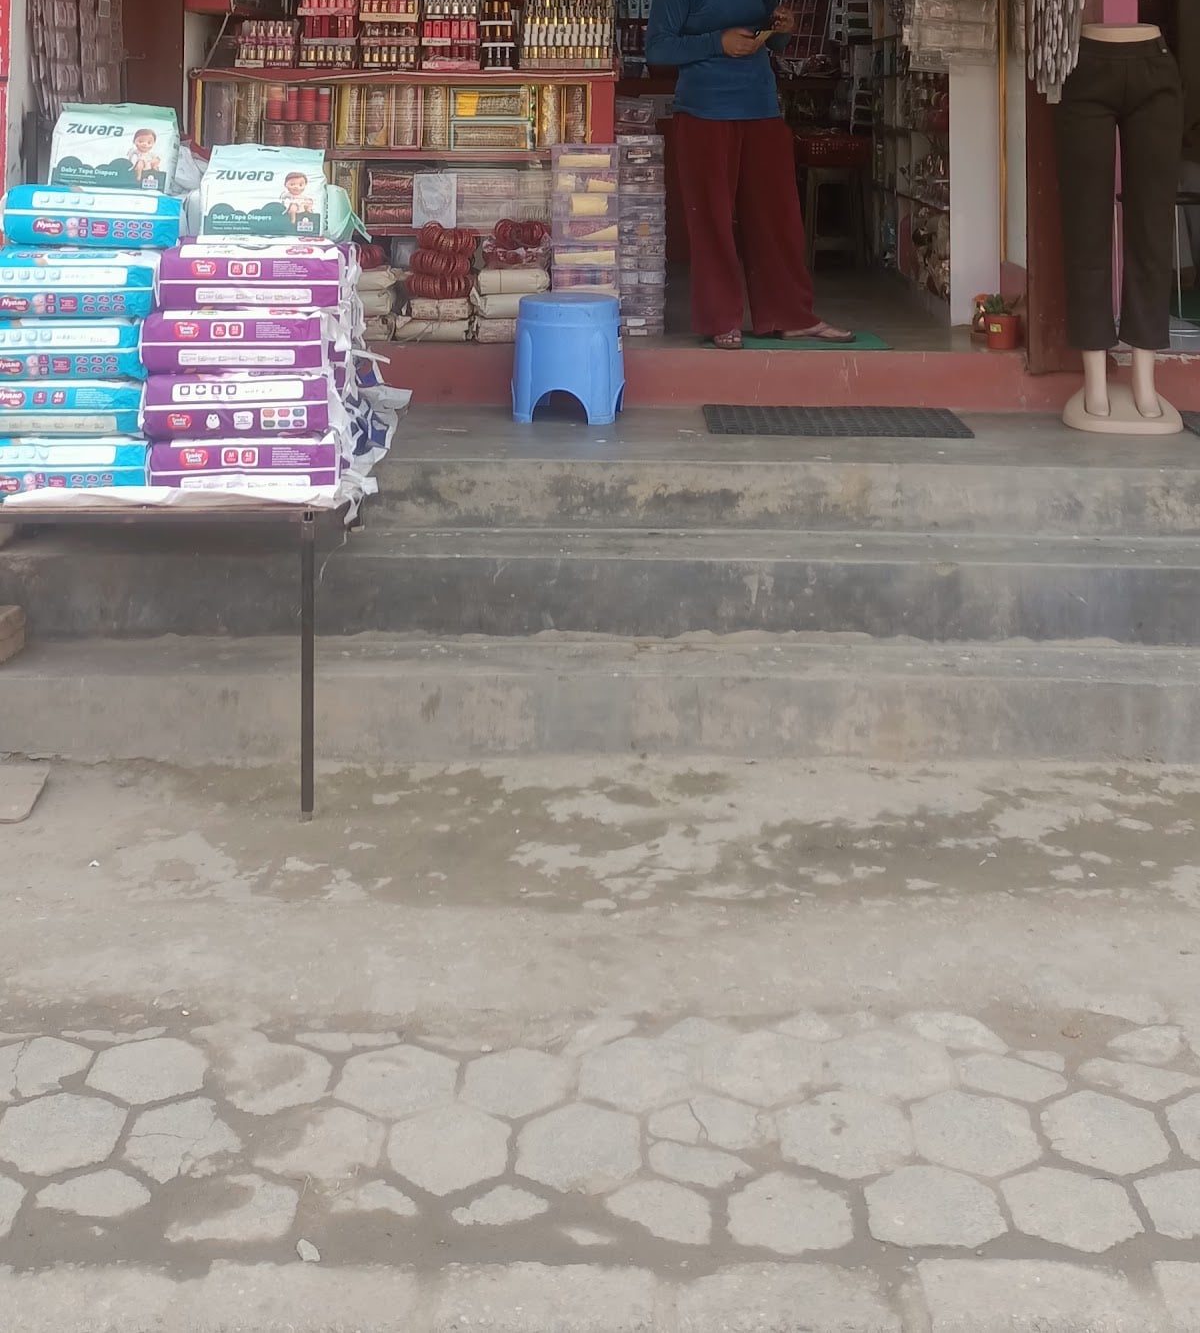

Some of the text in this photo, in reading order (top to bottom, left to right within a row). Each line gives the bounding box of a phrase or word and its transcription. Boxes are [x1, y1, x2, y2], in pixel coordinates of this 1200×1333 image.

[66, 123, 124, 137] zuvara
[61, 166, 118, 177] Baby Tape Diapers
[215, 169, 275, 181] zuvara
[212, 213, 228, 221] Baby
[36, 220, 60, 229] Nyano
[2, 299, 27, 307] Nyano
